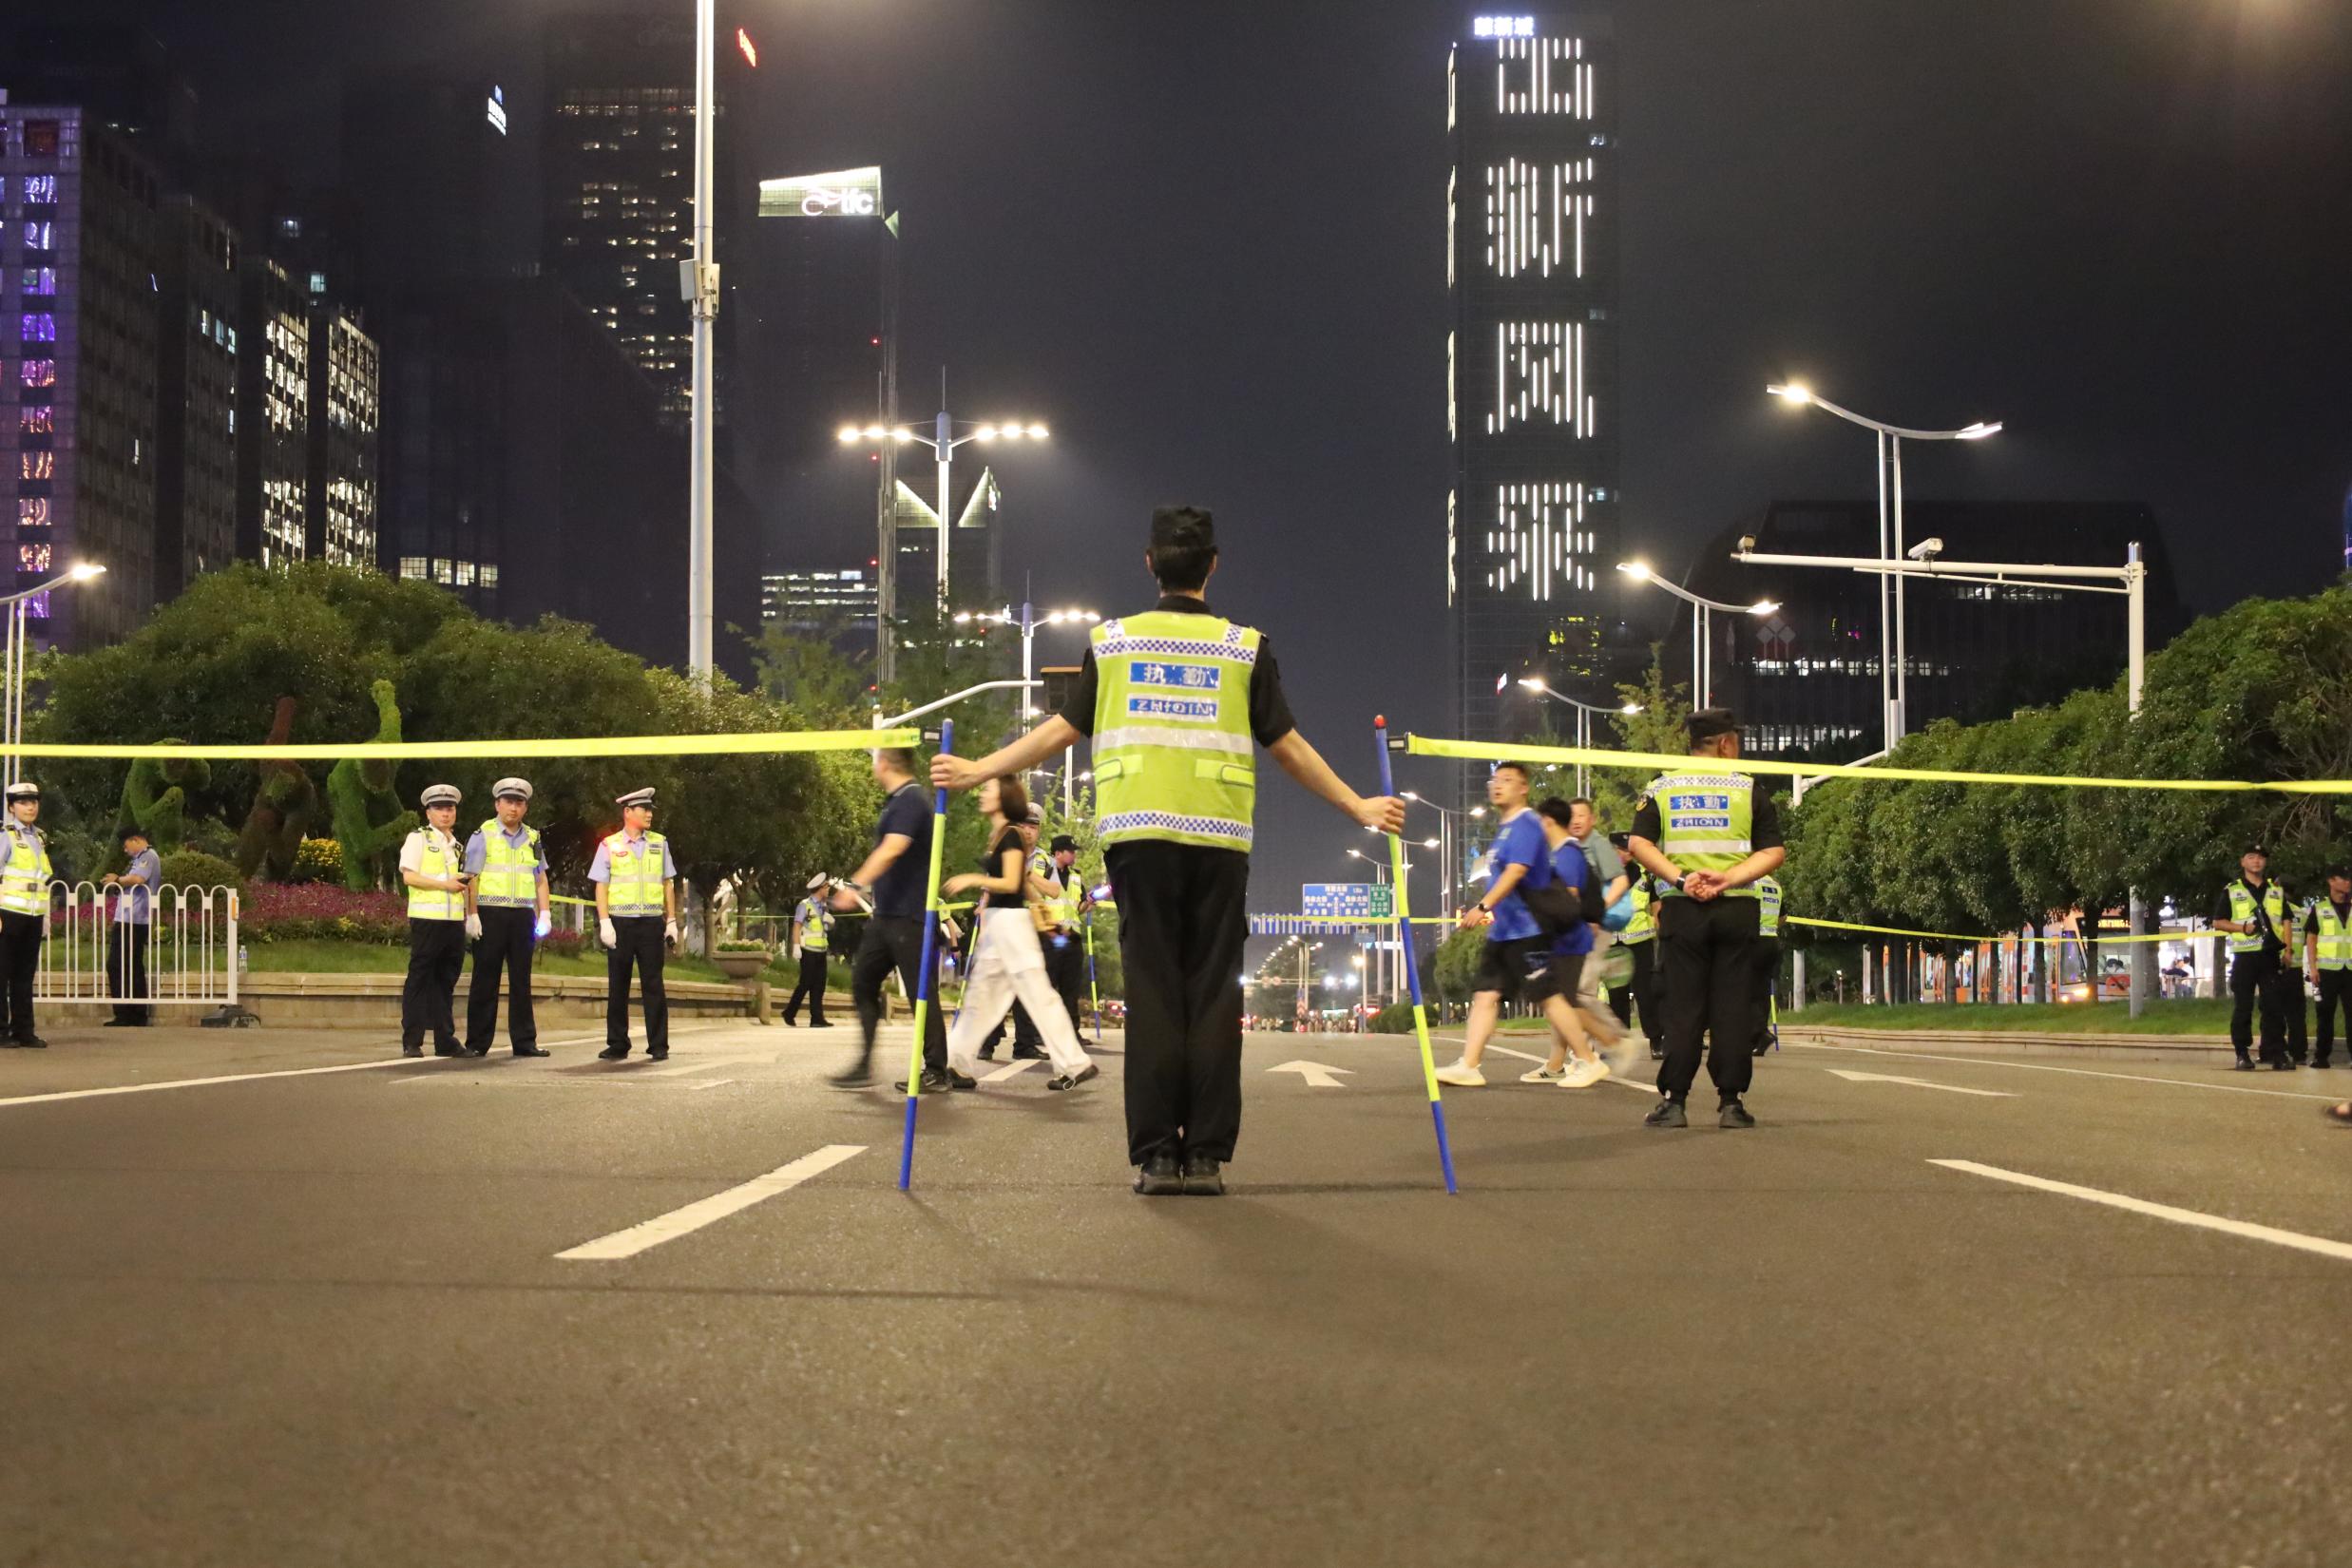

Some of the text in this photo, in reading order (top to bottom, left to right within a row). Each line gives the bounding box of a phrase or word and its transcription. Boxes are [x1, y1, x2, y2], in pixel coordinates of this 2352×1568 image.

[1144, 663, 1206, 685] 执勤
[1137, 699, 1213, 716] ZHIQIN
[1679, 795, 1720, 809] 执勤
[1675, 818, 1725, 828] ZHIQIN
